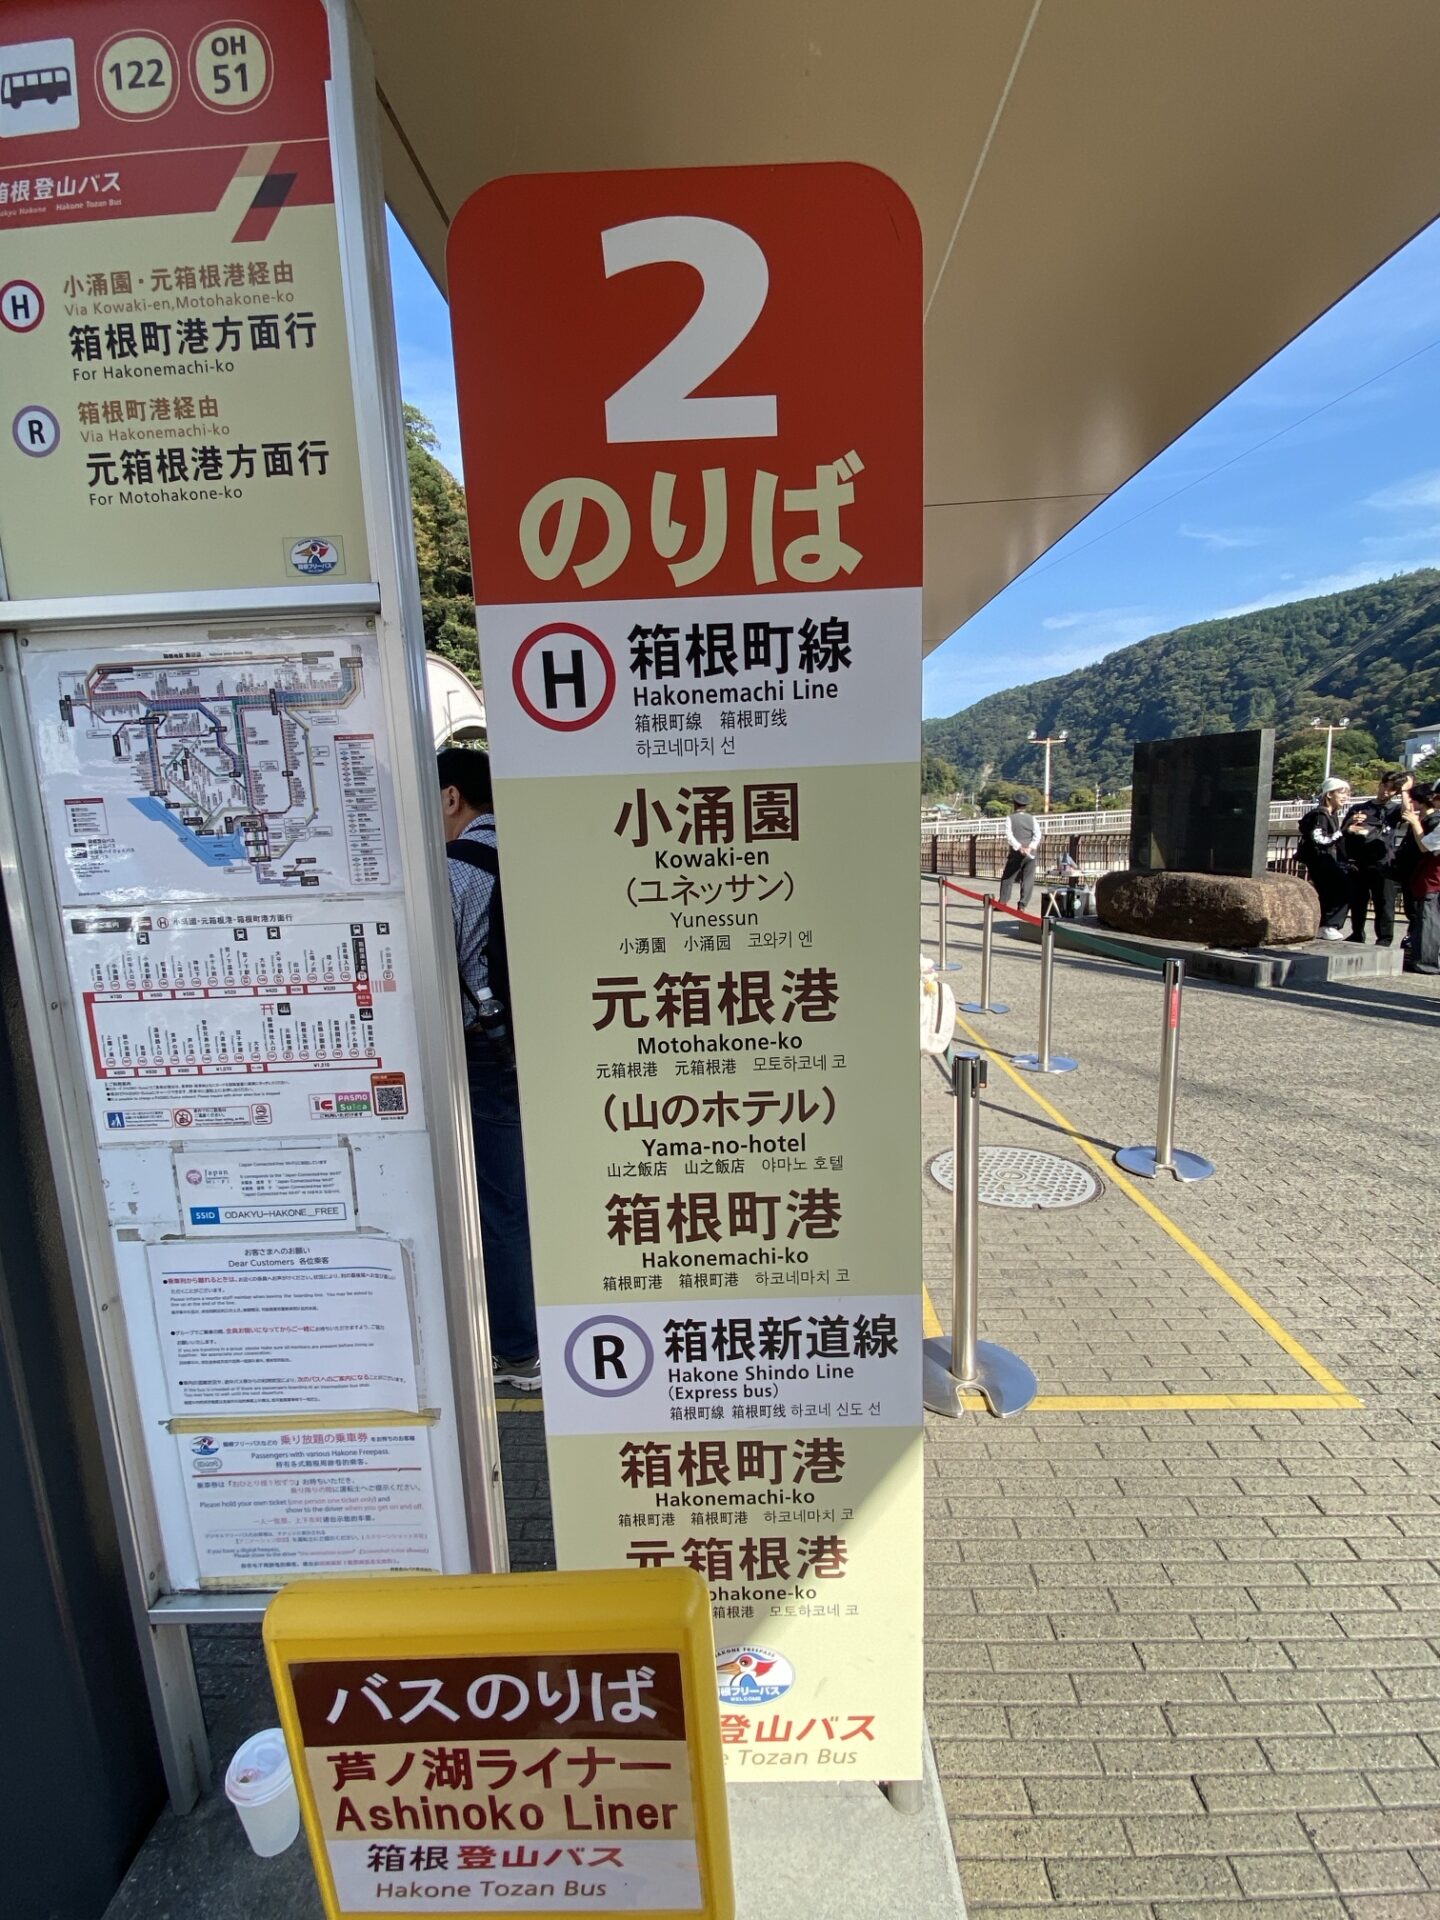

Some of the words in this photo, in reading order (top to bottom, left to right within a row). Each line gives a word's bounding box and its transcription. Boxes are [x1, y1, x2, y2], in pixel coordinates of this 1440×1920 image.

[211, 35, 247, 57] OH
[108, 58, 165, 91] 122
[213, 62, 248, 94] 51
[12, 294, 31, 320] H
[64, 303, 88, 317] Via
[93, 290, 295, 315] Kowaki-en,Motohakone-ko
[68, 311, 318, 362] 箱根町港方面行
[600, 215, 778, 444] 2
[73, 367, 97, 381] For
[103, 359, 235, 379] Hakonemachi-ko
[77, 395, 220, 425] 箱根町港経由
[28, 419, 46, 445] R
[80, 430, 104, 443] Via
[108, 424, 230, 441] Hakonemachi-ko
[86, 440, 330, 487] 元箱根港方面行
[89, 492, 114, 506] For
[119, 485, 243, 505] Motohakone-ko
[519, 449, 866, 589] のりば
[627, 616, 852, 681] 箱根町線
[541, 649, 587, 710] H
[633, 677, 786, 707] Hakonemachi
[793, 678, 839, 700] Line
[634, 711, 702, 733] 箱根町線
[635, 735, 715, 759] 하코네마치
[721, 736, 736, 756] 선
[613, 782, 800, 848] 小涌園
[655, 847, 770, 869] Kowaki-en
[670, 910, 759, 929] Yunessun
[747, 931, 793, 949] 코와키
[798, 930, 813, 948] 엔
[591, 967, 840, 1031] 元箱根港
[637, 1032, 803, 1055] Motohakone-ko
[596, 1061, 658, 1079] 元箱根港
[675, 1059, 737, 1077] 元箱根港
[753, 1055, 828, 1072] 모토하코네
[833, 1054, 847, 1069] 코
[338, 1094, 368, 1102] PASMO
[340, 1103, 368, 1111] Suica
[642, 1133, 806, 1157] Yama-no-hotel
[762, 1157, 806, 1173] 야마노
[813, 1155, 844, 1172] 호텔
[195, 1212, 216, 1220] SSID
[604, 1187, 842, 1246] 箱根町港
[228, 1260, 248, 1268] Dear
[250, 1258, 295, 1267] Customers
[642, 1248, 809, 1269] Hakonemachi-ko
[603, 1275, 663, 1291] 箱根町港
[679, 1272, 739, 1289] 箱根町港
[755, 1270, 831, 1287] 하코네마치
[835, 1269, 851, 1283] 코
[663, 1313, 899, 1364] 箱根新道線
[593, 1335, 628, 1380] R
[668, 1366, 739, 1383] Hakone
[746, 1364, 809, 1381] Shindo
[816, 1363, 854, 1380] Line
[670, 1405, 725, 1421] 箱根町線
[791, 1402, 832, 1418] 하코네
[836, 1401, 863, 1417] 신도
[868, 1401, 881, 1416] 선
[618, 1437, 846, 1489] 箱根町港
[656, 1488, 815, 1508] Hakonemachi-ko
[618, 1512, 675, 1528] 箱根町港
[691, 1511, 748, 1526] 箱根町港
[763, 1509, 836, 1525] 하코네마치
[709, 1585, 817, 1602] ohakone-ko
[712, 1605, 755, 1620] 箱根港
[326, 1665, 658, 1724] バスのりば
[720, 1714, 875, 1744] 登山バス
[327, 1746, 672, 1792] 芦ノ湖ライナー
[738, 1749, 808, 1766] Tozan
[817, 1748, 857, 1765] Bus
[335, 1795, 544, 1832] Ashinoko
[564, 1796, 678, 1831] Liner
[367, 1844, 625, 1873] 箱根登山バス
[376, 1881, 471, 1899] Hakone
[480, 1880, 554, 1898] Tozan
[565, 1880, 607, 1897] Bus
